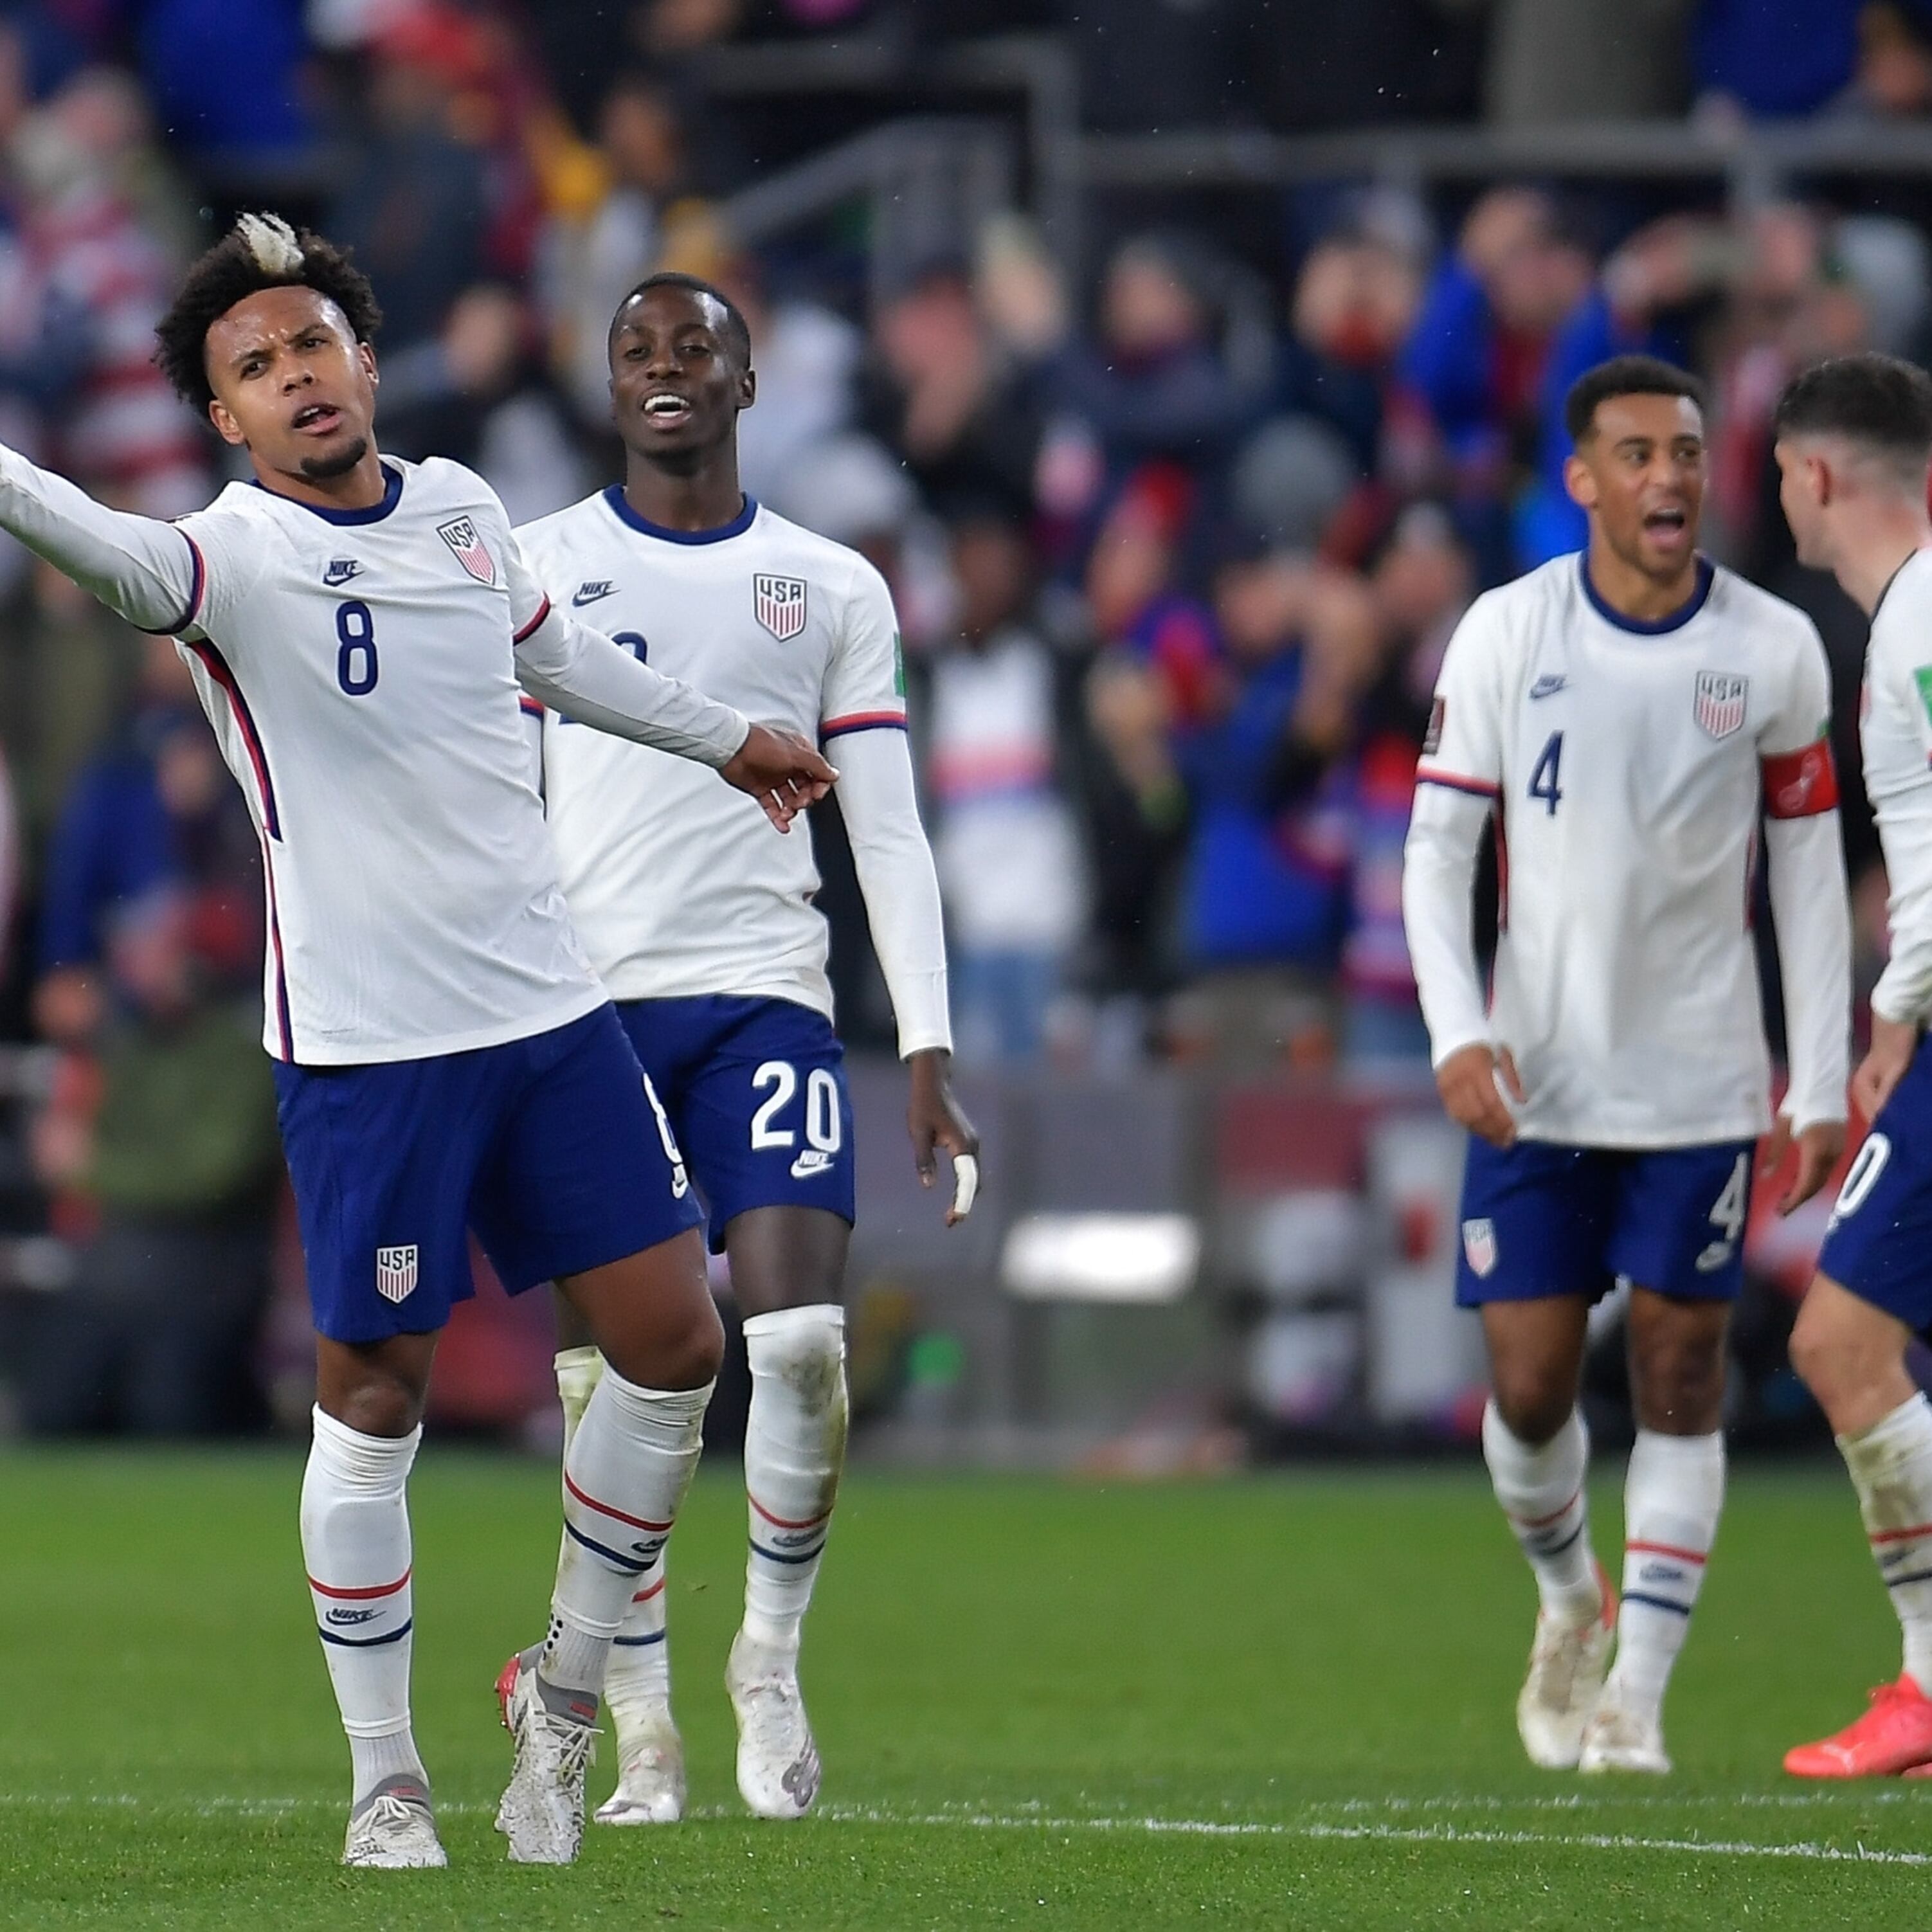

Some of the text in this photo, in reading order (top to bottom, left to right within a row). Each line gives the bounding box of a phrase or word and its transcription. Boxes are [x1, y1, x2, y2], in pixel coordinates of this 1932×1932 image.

[444, 522, 475, 548] USA
[328, 560, 358, 576] NIKE
[579, 581, 613, 596] NIKE
[760, 579, 801, 603] USA
[336, 600, 378, 696] 8
[1702, 676, 1741, 701] USA
[1527, 730, 1564, 817] 4
[751, 1061, 840, 1152] 20
[1708, 1152, 1748, 1240] 4
[380, 1249, 415, 1270] USA
[332, 1608, 374, 1621] NIKE
